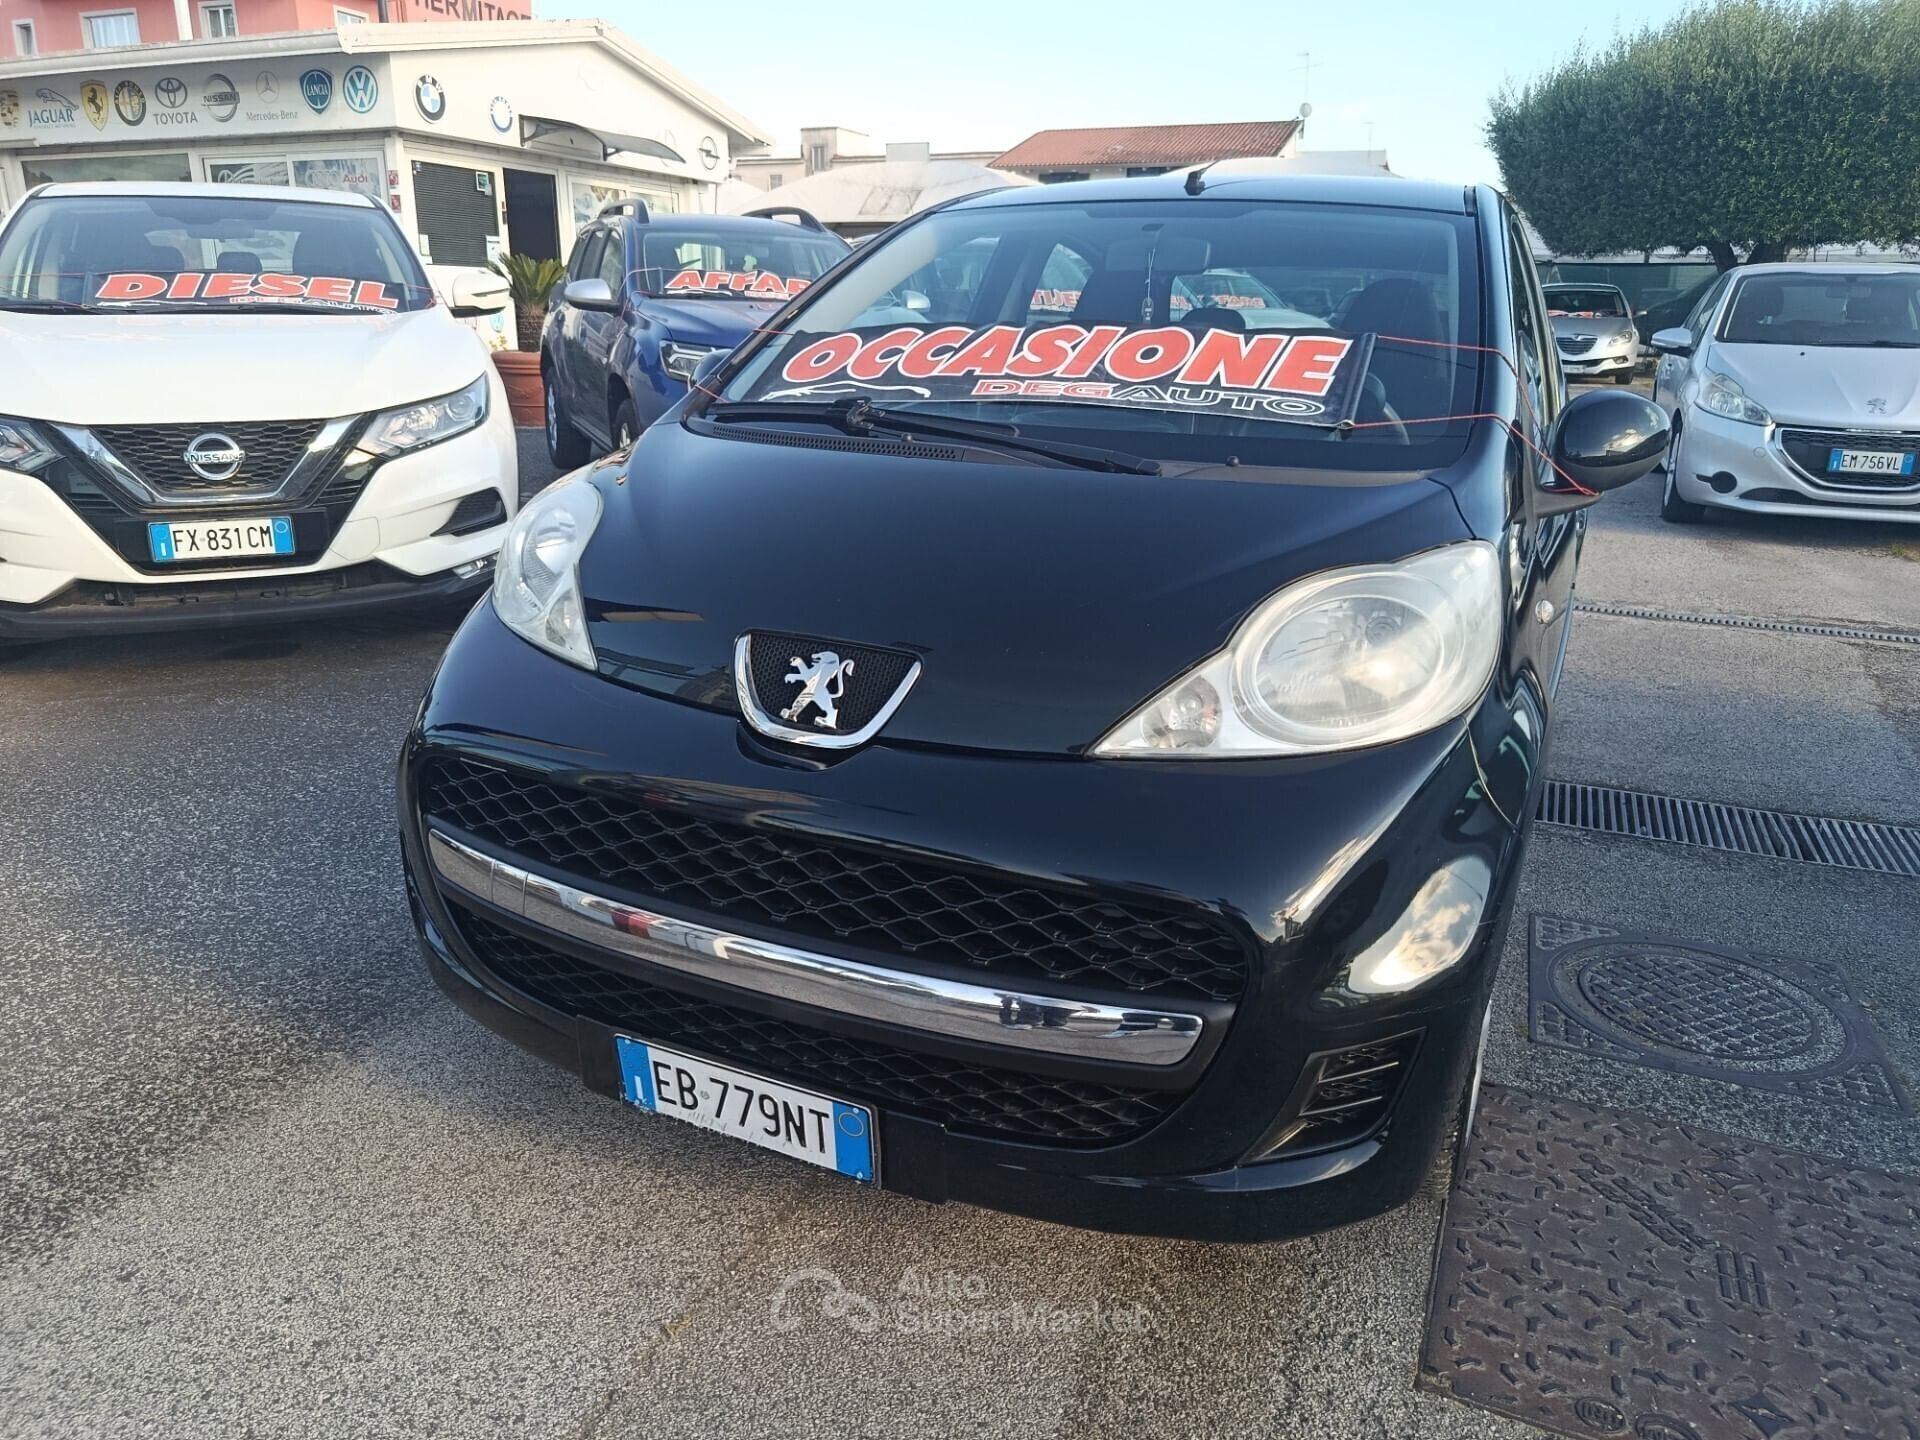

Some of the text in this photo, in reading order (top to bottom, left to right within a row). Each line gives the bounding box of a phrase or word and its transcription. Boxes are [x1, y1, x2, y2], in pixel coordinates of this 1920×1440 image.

[306, 83, 329, 96] LANCIA
[203, 95, 237, 104] NISSAN
[28, 108, 75, 128] JAGUAR
[153, 112, 198, 125] TOYOTA
[246, 110, 298, 121] Mercedes-Benz
[343, 173, 368, 184] Audi
[95, 273, 399, 309] DIESEL
[782, 324, 1353, 396] OCCASIONE
[190, 453, 238, 462] NISSAN
[172, 529, 200, 552] FX
[652, 1060, 699, 1111] EB
